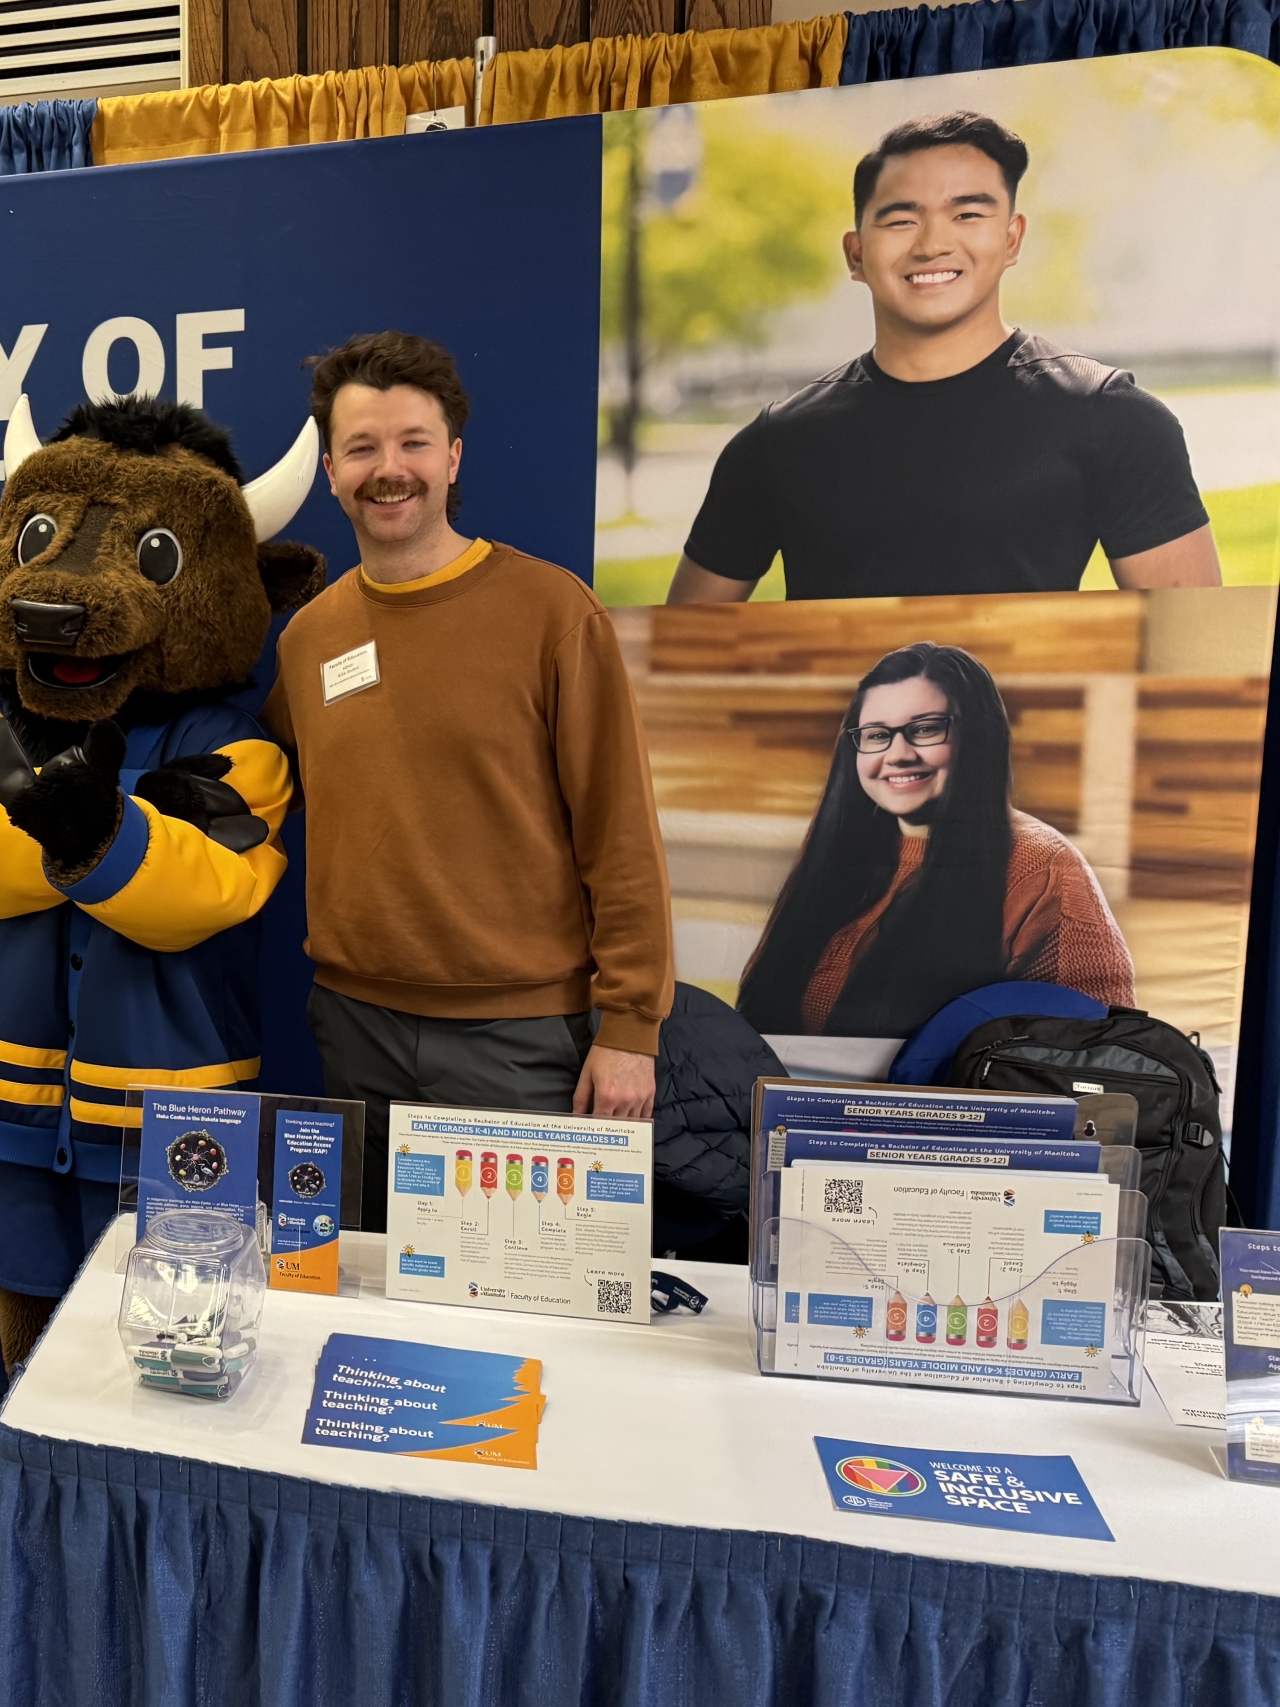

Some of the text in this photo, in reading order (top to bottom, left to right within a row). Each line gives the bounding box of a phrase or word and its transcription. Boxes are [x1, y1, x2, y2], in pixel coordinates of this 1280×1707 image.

[81, 308, 245, 410] OF
[168, 1104, 185, 1112] Blue
[187, 1105, 211, 1113] Heron
[213, 1107, 246, 1117] Pathway
[846, 1107, 881, 1115] SENIOR
[915, 1110, 957, 1119] (GRADES
[959, 1113, 982, 1121] 9-12)
[433, 1114, 466, 1122] Completing
[563, 1124, 595, 1132] University
[413, 1123, 626, 1145] EARLY (GRADES K-4) AND MIDDLE YEARS (GRADES 5-8)
[839, 1141, 878, 1149] Completing
[994, 1148, 1031, 1156] University
[869, 1151, 904, 1159] SENIOR
[939, 1154, 981, 1163] (GRADES
[983, 1156, 1006, 1164] 9-12)
[893, 1186, 928, 1194] Education
[939, 1188, 964, 1196] Faculty
[1248, 1243, 1270, 1251] Steps
[286, 1262, 300, 1270] UM
[510, 1293, 531, 1301] Faculty
[540, 1295, 570, 1304] Education
[826, 1353, 1079, 1380] EARLY (GRADES K-4) AND MIDDLE YEARS (GRADES 5-8)
[338, 1365, 446, 1393] Thinking about
[322, 1400, 394, 1414] teaching?
[324, 1390, 437, 1410] Thinking about
[315, 1427, 389, 1442] teaching?
[317, 1418, 434, 1438] Thinking about
[929, 1461, 983, 1472] WELCOME
[933, 1470, 1026, 1488] SAFE &
[938, 1482, 1083, 1505] INCLUSIVE
[944, 1495, 1032, 1514] SPACE
